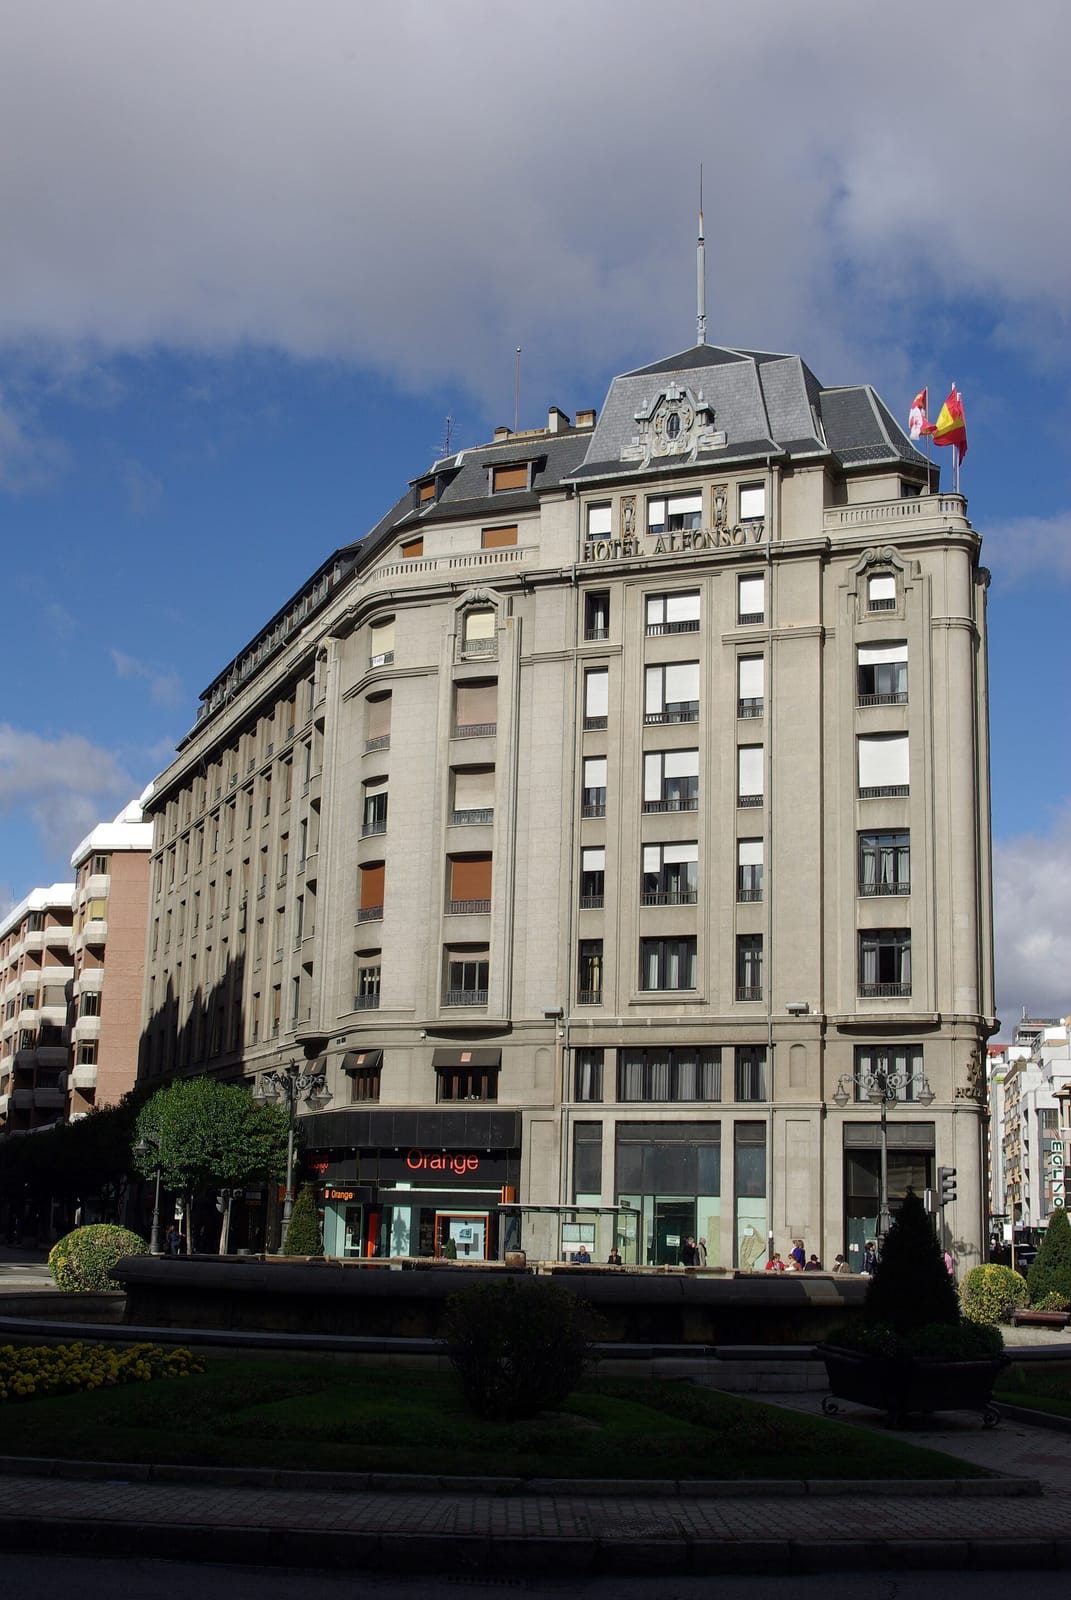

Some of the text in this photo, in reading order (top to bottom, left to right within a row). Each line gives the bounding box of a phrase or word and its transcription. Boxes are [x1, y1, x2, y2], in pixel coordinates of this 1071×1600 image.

[582, 522, 765, 562] HOTEL ALFONSO V
[407, 1149, 479, 1175] Orange
[331, 1190, 353, 1201] Orange
